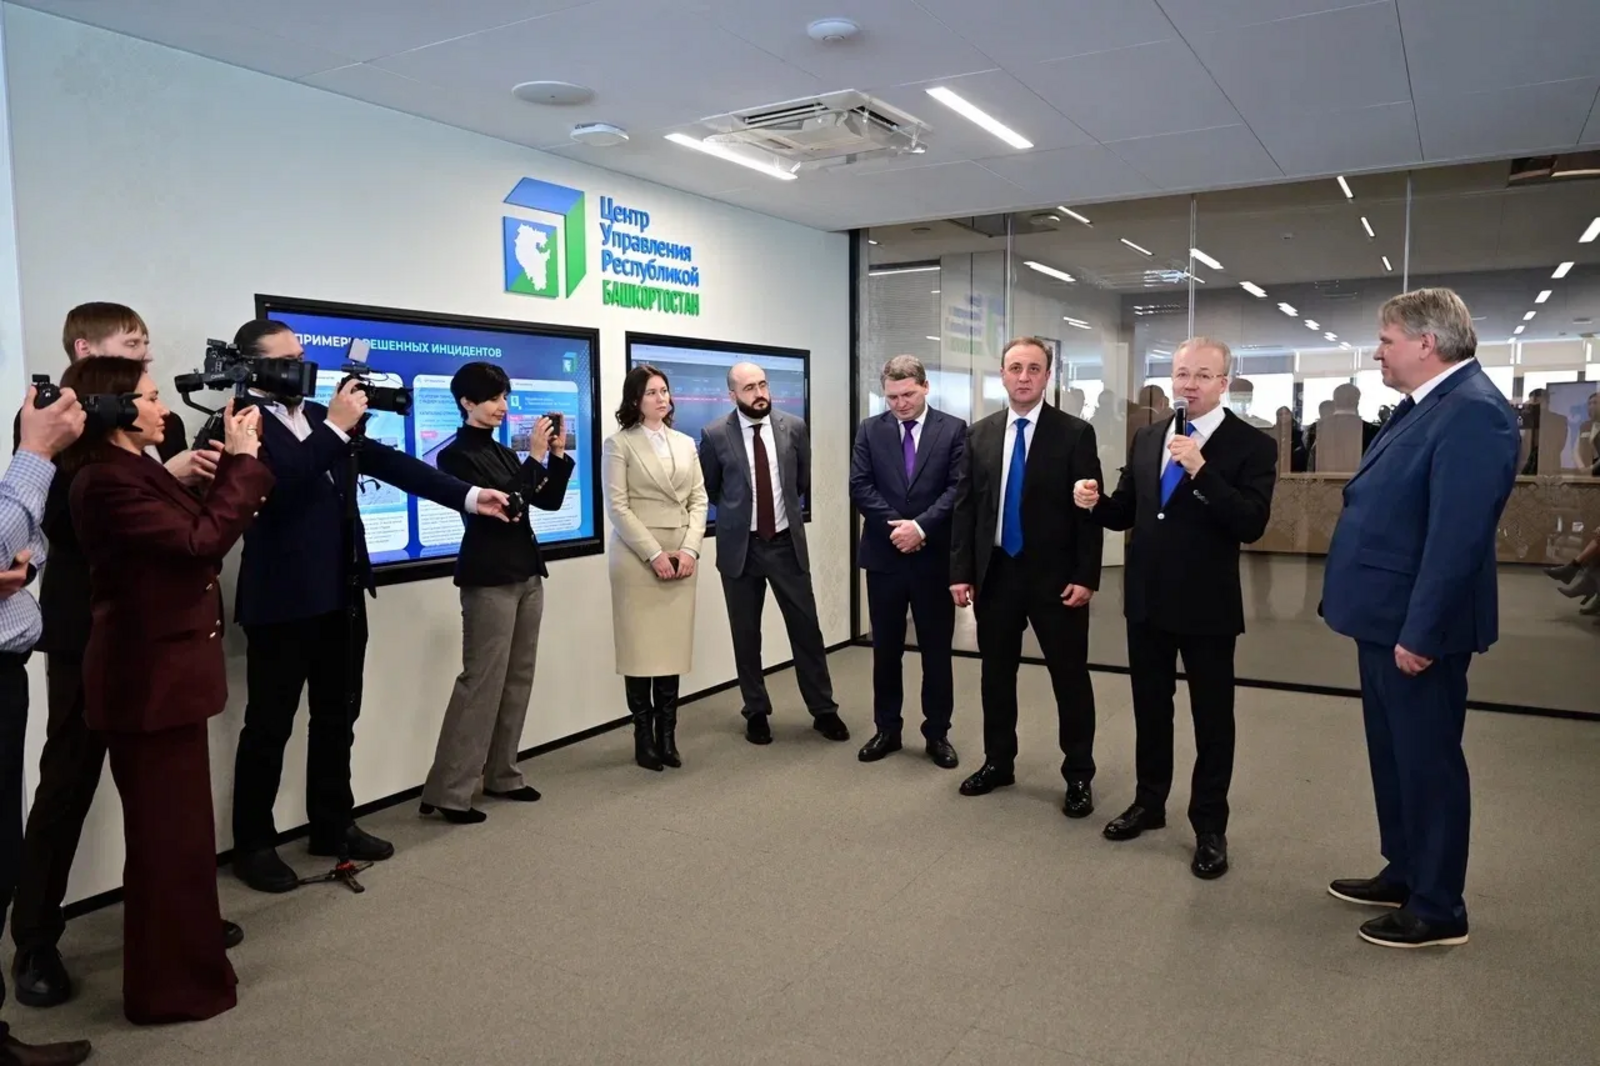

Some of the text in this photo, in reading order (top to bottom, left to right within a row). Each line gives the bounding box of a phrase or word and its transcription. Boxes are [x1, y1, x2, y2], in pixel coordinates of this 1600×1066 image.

[600, 195, 651, 233] Центр
[599, 221, 692, 262] Управления
[601, 248, 700, 288] Республикой
[602, 279, 700, 317] БАШКОРТОСТАН
[294, 332, 353, 348] ПРИМЕР
[431, 344, 503, 358] ИНЦИДЕНТОВ
